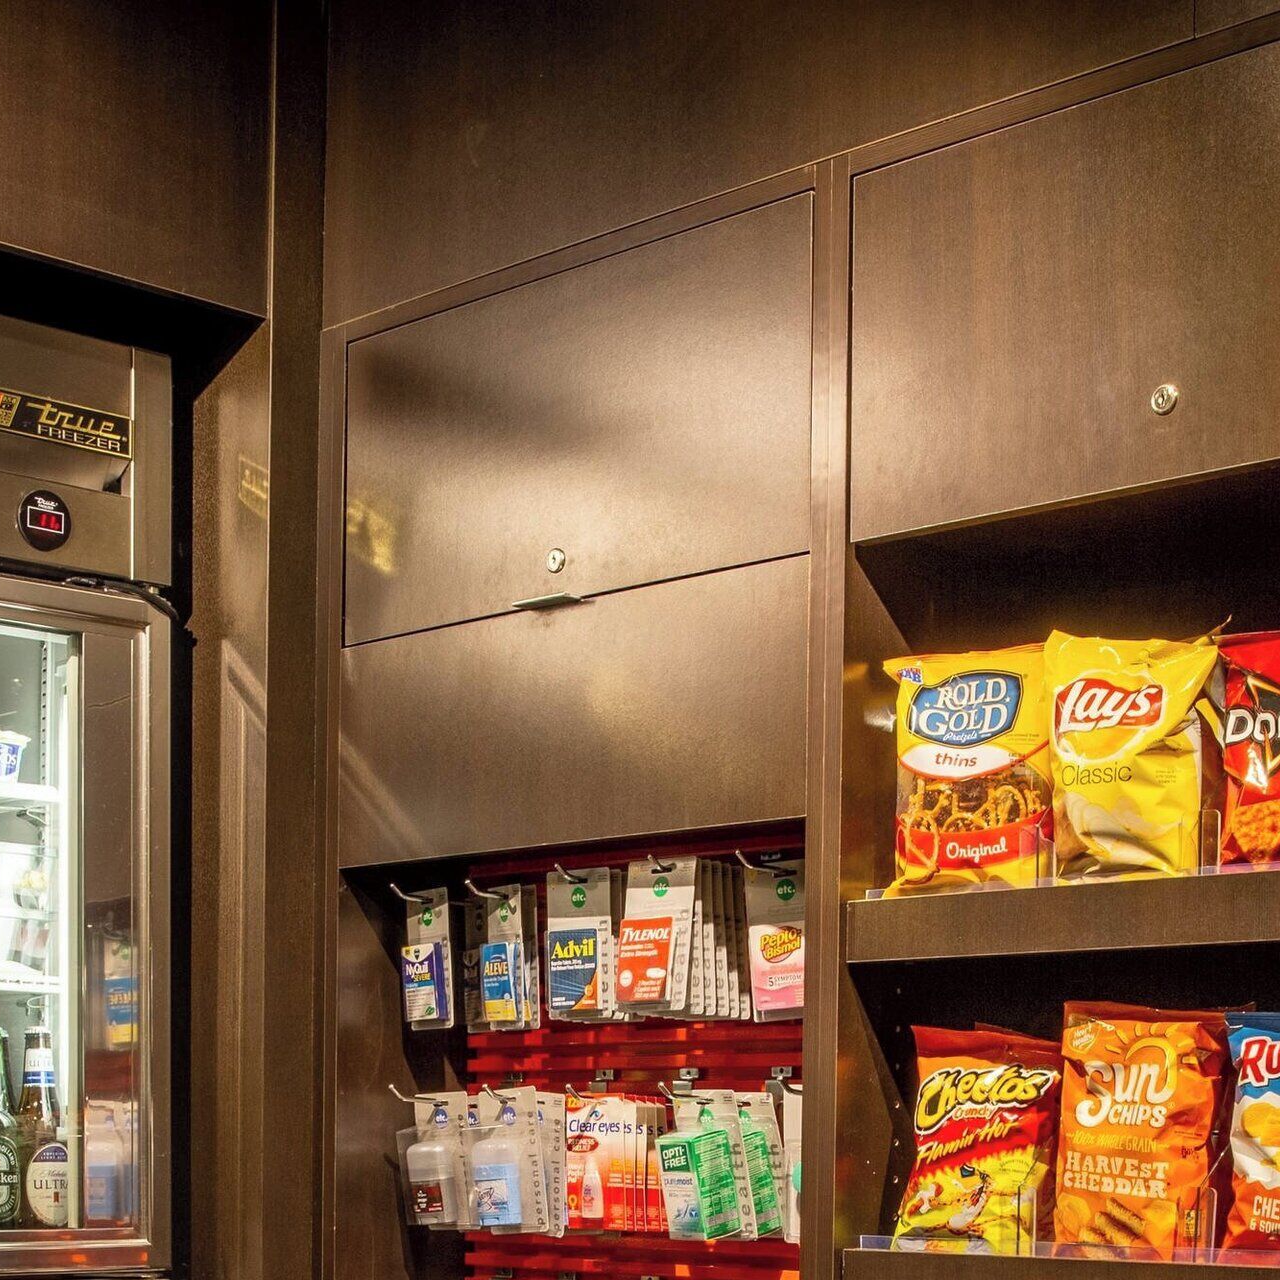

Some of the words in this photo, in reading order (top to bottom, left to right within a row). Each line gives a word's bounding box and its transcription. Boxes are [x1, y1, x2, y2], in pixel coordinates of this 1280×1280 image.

[37, 424, 120, 451] FREEZER
[937, 673, 1009, 708] ROLD
[919, 703, 1009, 736] GOLD
[942, 730, 978, 742] Pretzels
[933, 750, 977, 769] thins
[1061, 761, 1133, 788] Classic
[945, 836, 1008, 862] Original
[622, 928, 669, 943] TYLENOL
[551, 938, 596, 960] Advil
[765, 938, 802, 958] Bismol
[405, 961, 429, 981] NyQuil
[484, 961, 508, 976] ALEVE
[768, 976, 774, 987] 5
[917, 1065, 1046, 1130] Cheetos
[1075, 1055, 1177, 1128] Sun
[527, 1111, 536, 1145] care
[569, 1119, 596, 1133] Clear
[598, 1121, 621, 1135] eyes
[1108, 1104, 1168, 1128] CHIPS
[664, 1158, 687, 1170] FREE
[1065, 1151, 1169, 1178] HARVEST
[528, 1153, 546, 1226] personal
[1063, 1174, 1168, 1199] CHEDDAR
